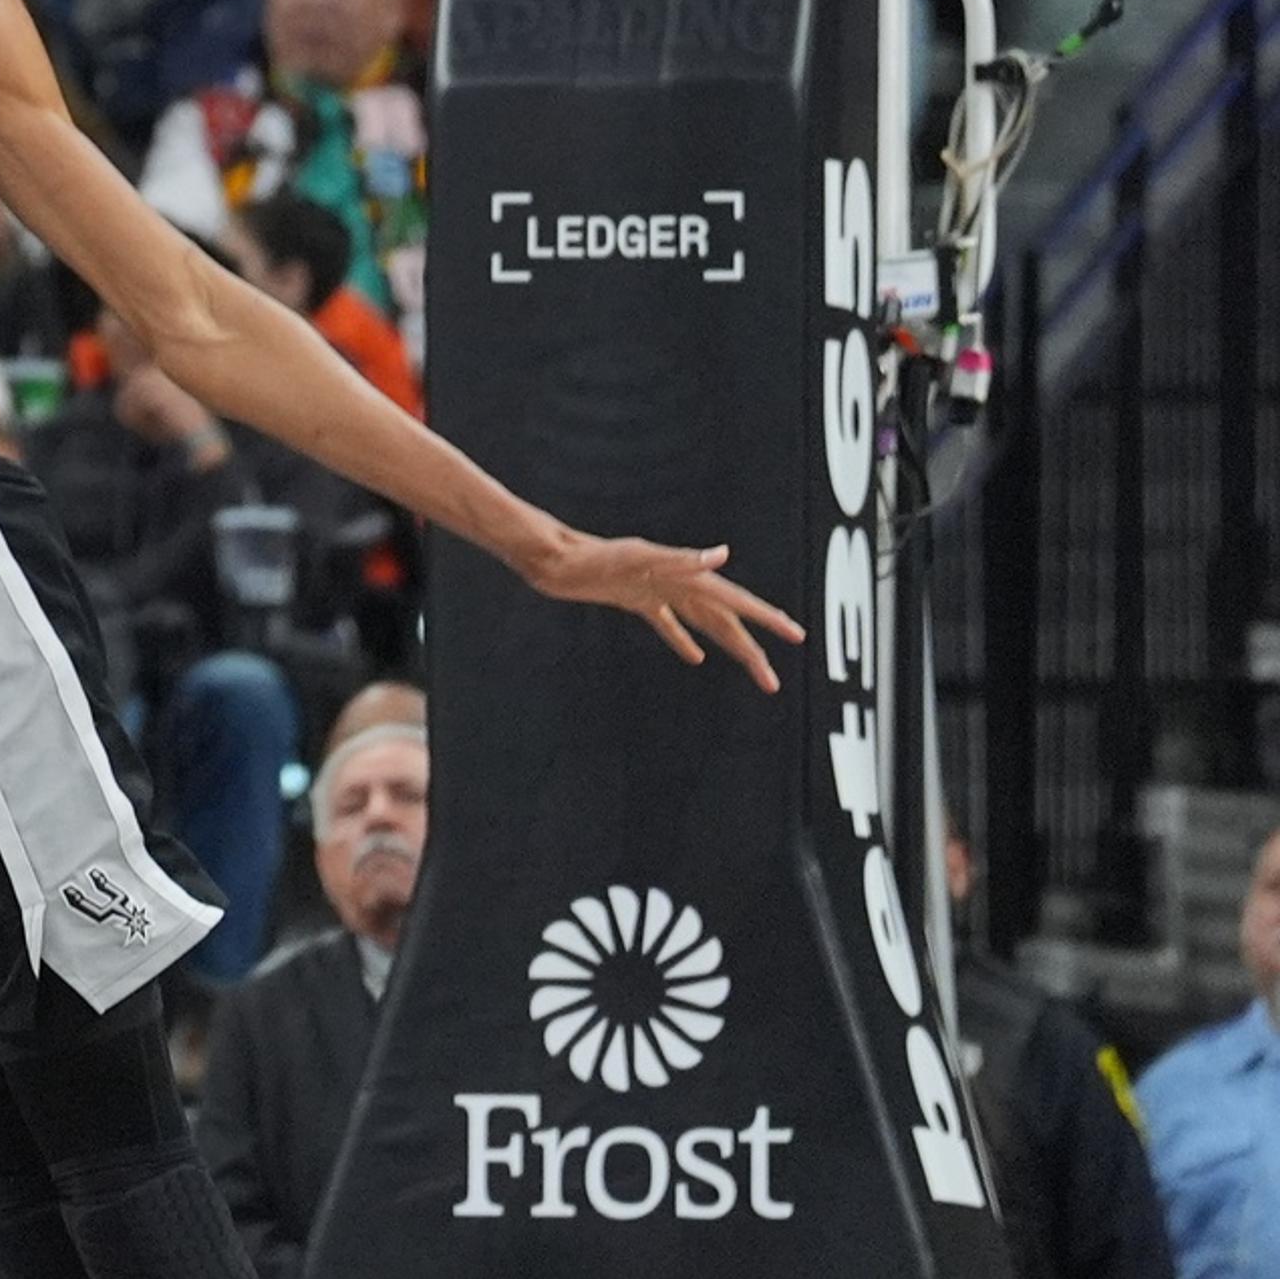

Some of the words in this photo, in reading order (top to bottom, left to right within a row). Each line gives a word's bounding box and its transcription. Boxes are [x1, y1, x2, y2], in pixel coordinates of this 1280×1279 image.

[526, 214, 710, 259] LEDGER
[824, 157, 986, 1208] bet365
[452, 1093, 795, 1220] Frost
